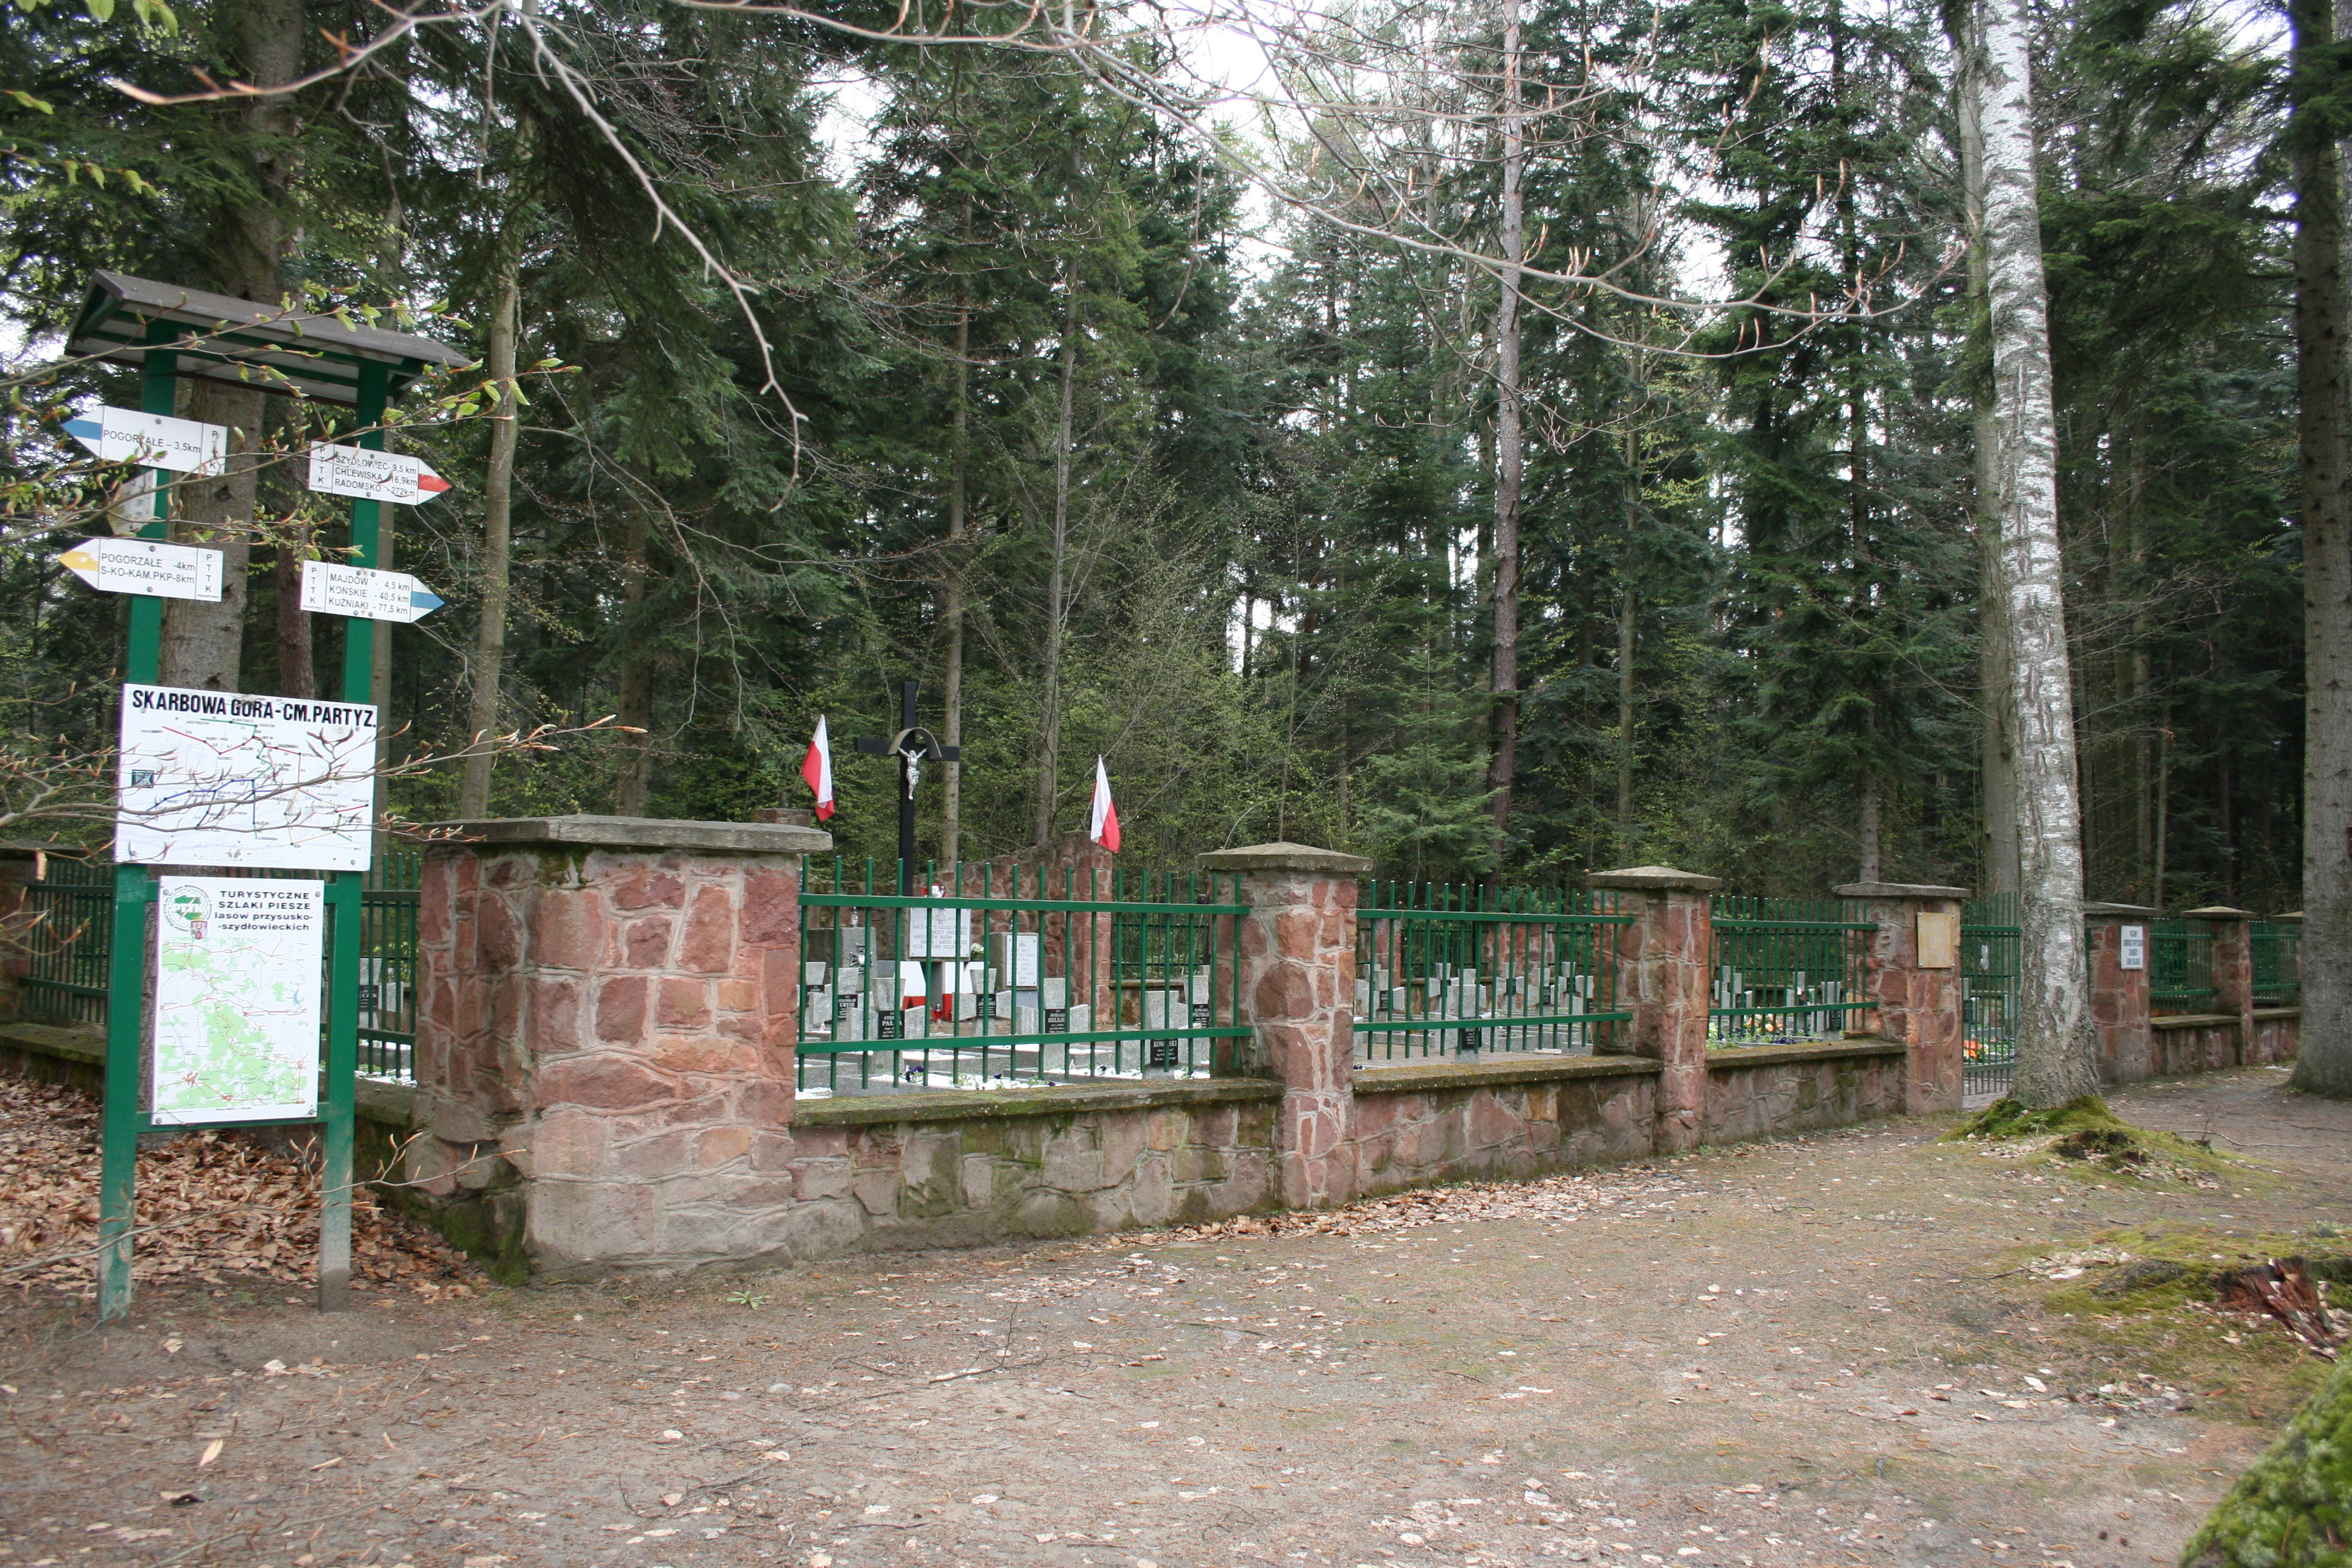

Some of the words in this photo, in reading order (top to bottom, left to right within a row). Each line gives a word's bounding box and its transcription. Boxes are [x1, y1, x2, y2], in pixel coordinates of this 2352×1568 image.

[103, 430, 164, 448] POGORAŁE
[174, 441, 201, 454] 3,5km
[335, 467, 383, 482] CHLEWISKA
[405, 466, 417, 474] km
[335, 478, 382, 492] RADOMSKO
[101, 553, 163, 568] POGORZAŁE
[329, 584, 368, 598] KOŃSKIE
[379, 591, 396, 602] 40,5
[397, 593, 410, 603] km
[384, 581, 396, 590] 4,5
[398, 582, 410, 592] km
[378, 603, 394, 613] 77,5
[396, 605, 408, 615] km
[132, 689, 227, 715] SKARBOWA
[220, 890, 310, 900] TURYSTYCZNE
[218, 923, 309, 931] -szydłowieckich
